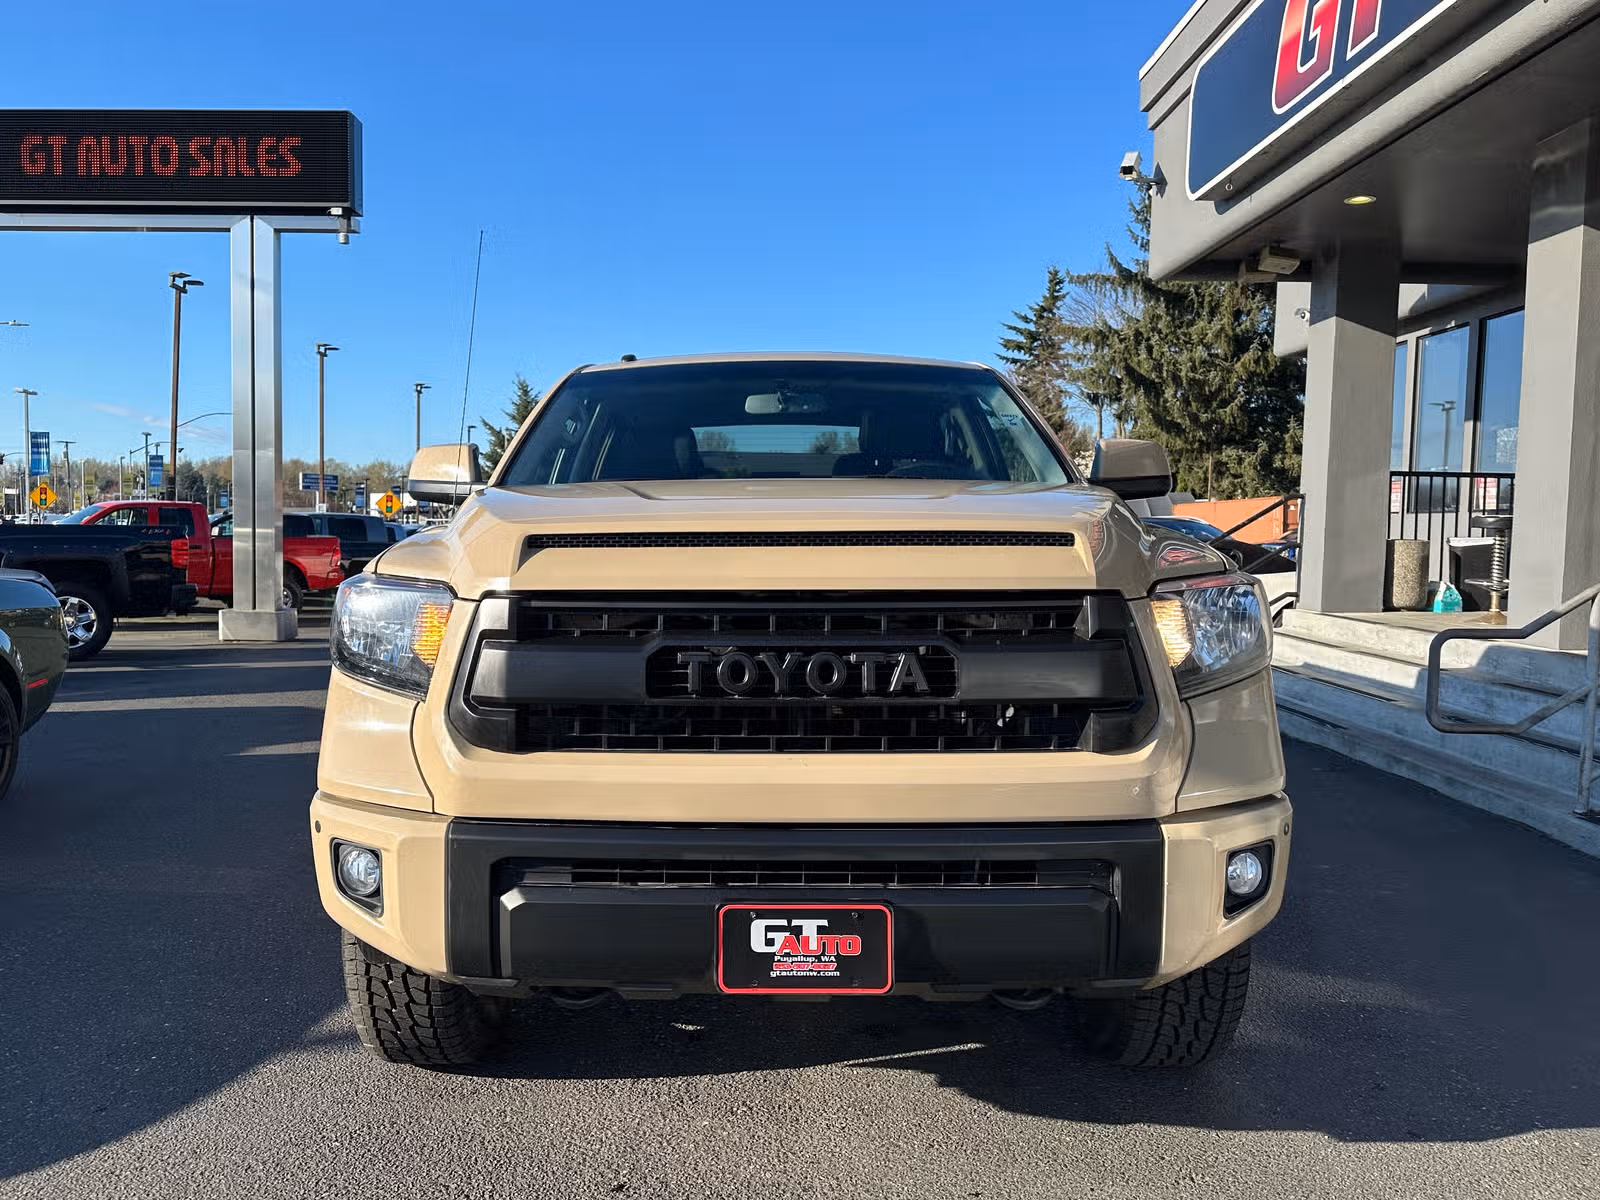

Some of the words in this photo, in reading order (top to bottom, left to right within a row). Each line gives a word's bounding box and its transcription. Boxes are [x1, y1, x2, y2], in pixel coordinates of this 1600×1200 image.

[20, 134, 67, 176] GT
[77, 135, 179, 177] AUTO
[189, 136, 303, 177] SALES
[677, 651, 929, 694] TOYOTA
[750, 919, 829, 953] GT
[776, 934, 862, 956] AUTO
[774, 955, 818, 963] Puyallup,
